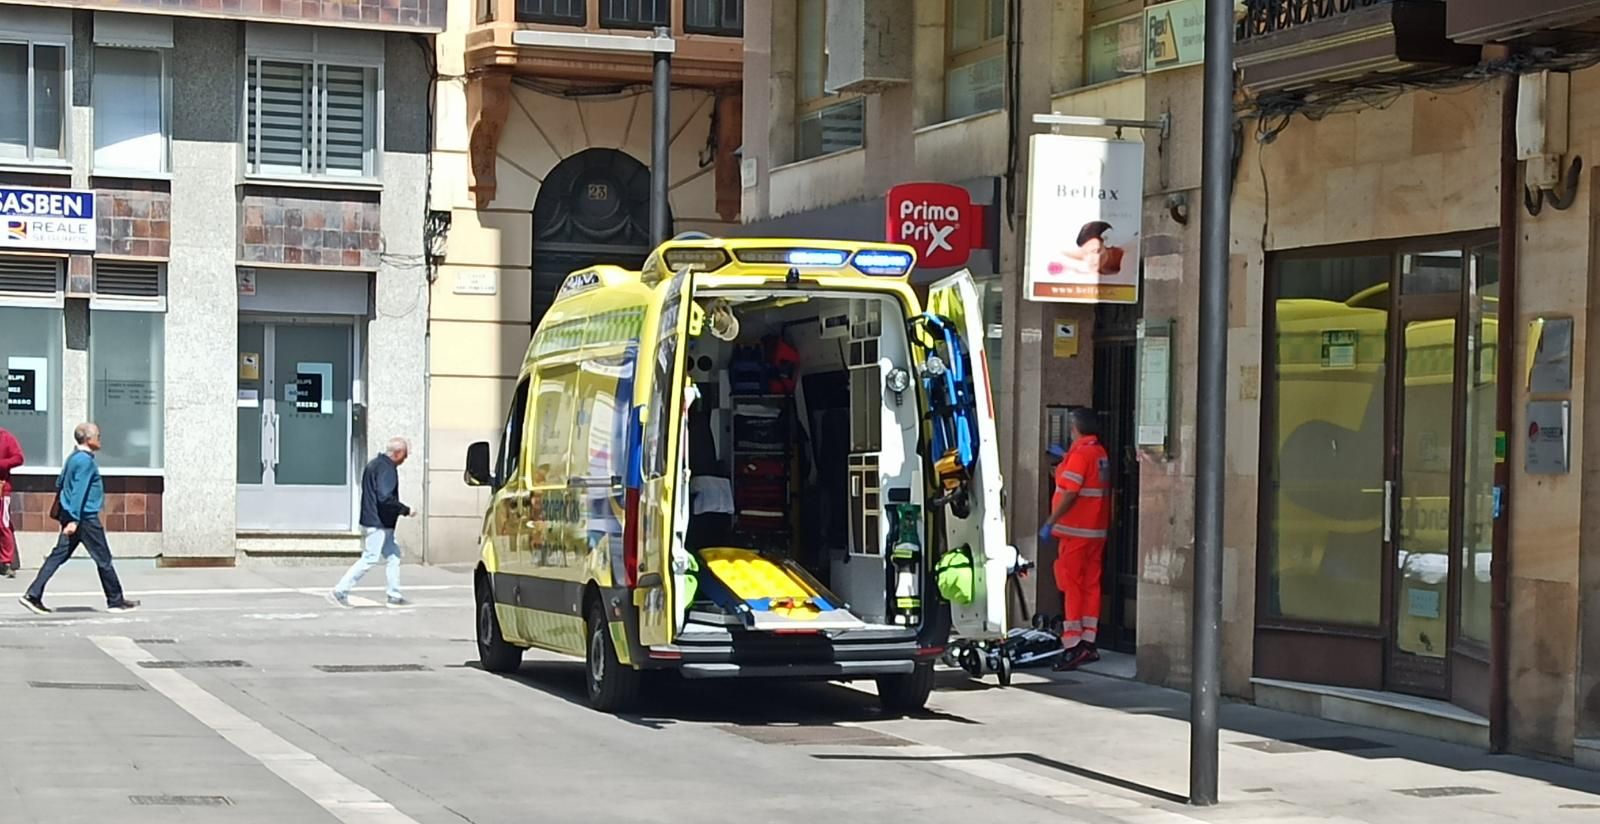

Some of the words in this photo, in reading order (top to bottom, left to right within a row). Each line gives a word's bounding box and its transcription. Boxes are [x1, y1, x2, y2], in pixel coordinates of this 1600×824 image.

[1057, 184, 1120, 200] Bellax
[0, 192, 82, 216] ASBEN
[900, 200, 959, 221] Prima
[32, 221, 88, 234] REALE
[901, 221, 955, 258] PriX
